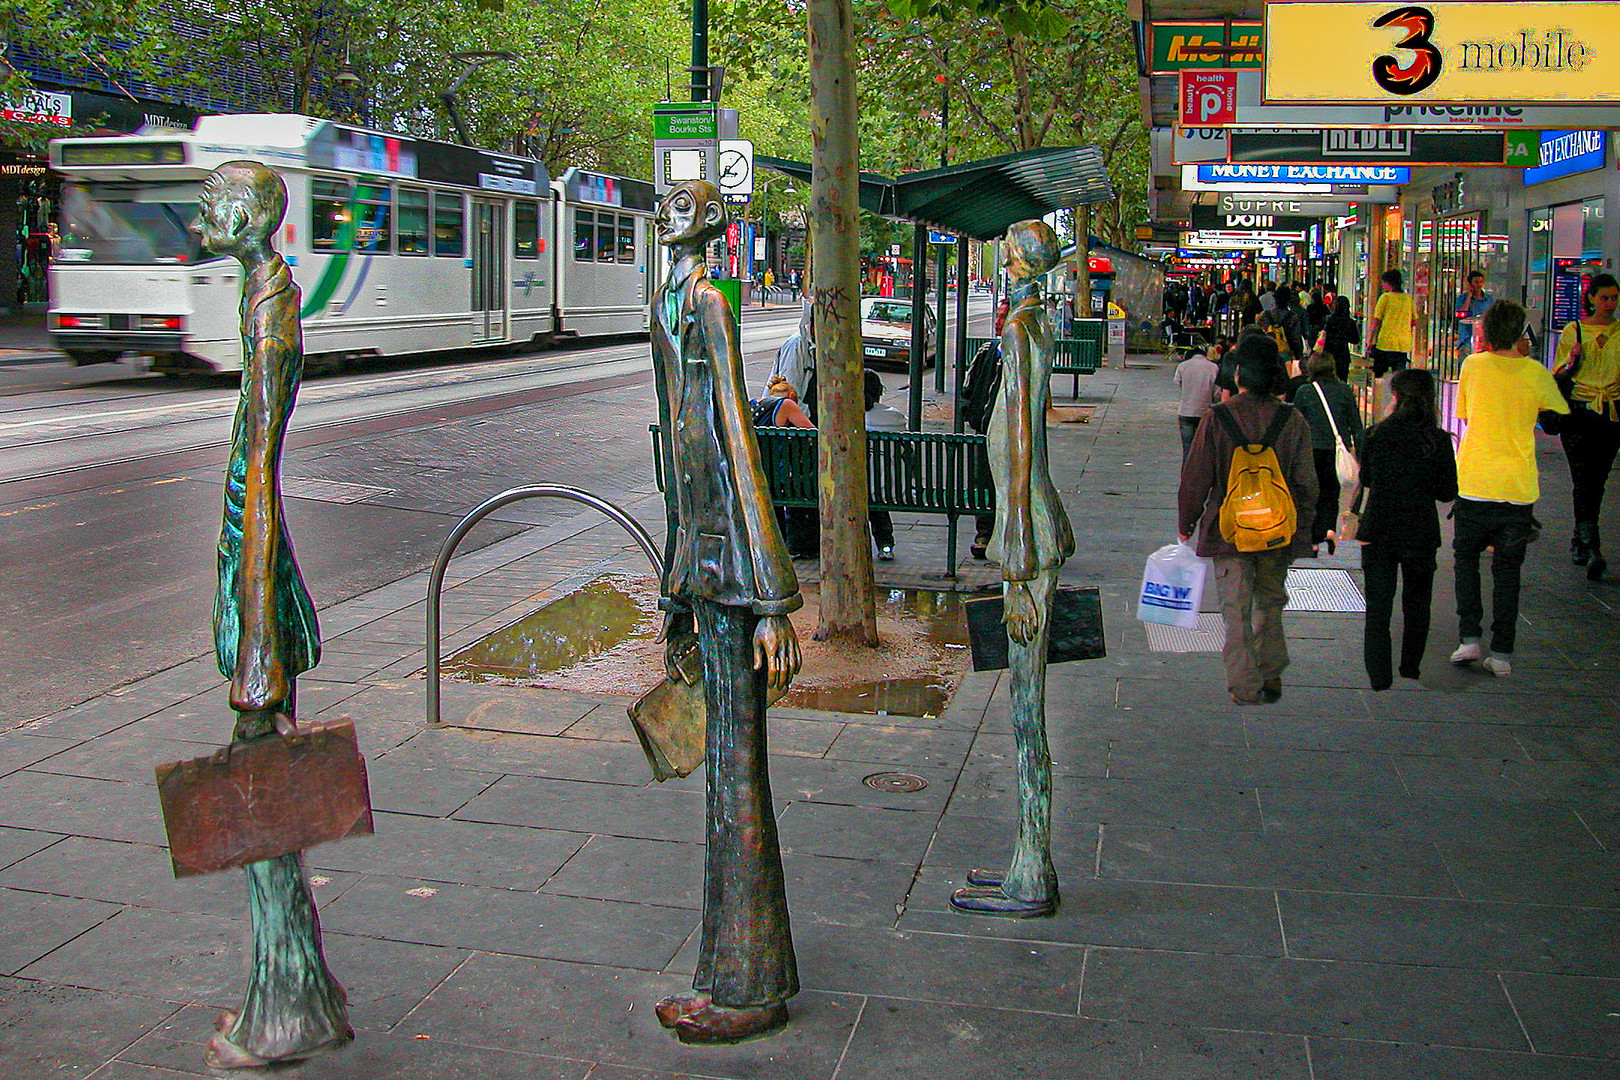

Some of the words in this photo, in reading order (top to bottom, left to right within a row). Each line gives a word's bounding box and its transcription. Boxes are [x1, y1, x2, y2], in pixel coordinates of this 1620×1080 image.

[1372, 6, 1443, 96] 3
[1461, 31, 1587, 69] mobile
[1196, 74, 1225, 82] health
[1185, 83, 1195, 114] beauty
[1225, 86, 1235, 112] home
[669, 125, 697, 133] Bourke
[698, 124, 712, 133] Sts
[1, 165, 46, 176] MDTdesign
[1211, 165, 1281, 178] MONEY
[1286, 166, 1397, 180] EXCHANGE
[1145, 581, 1172, 597] BIG
